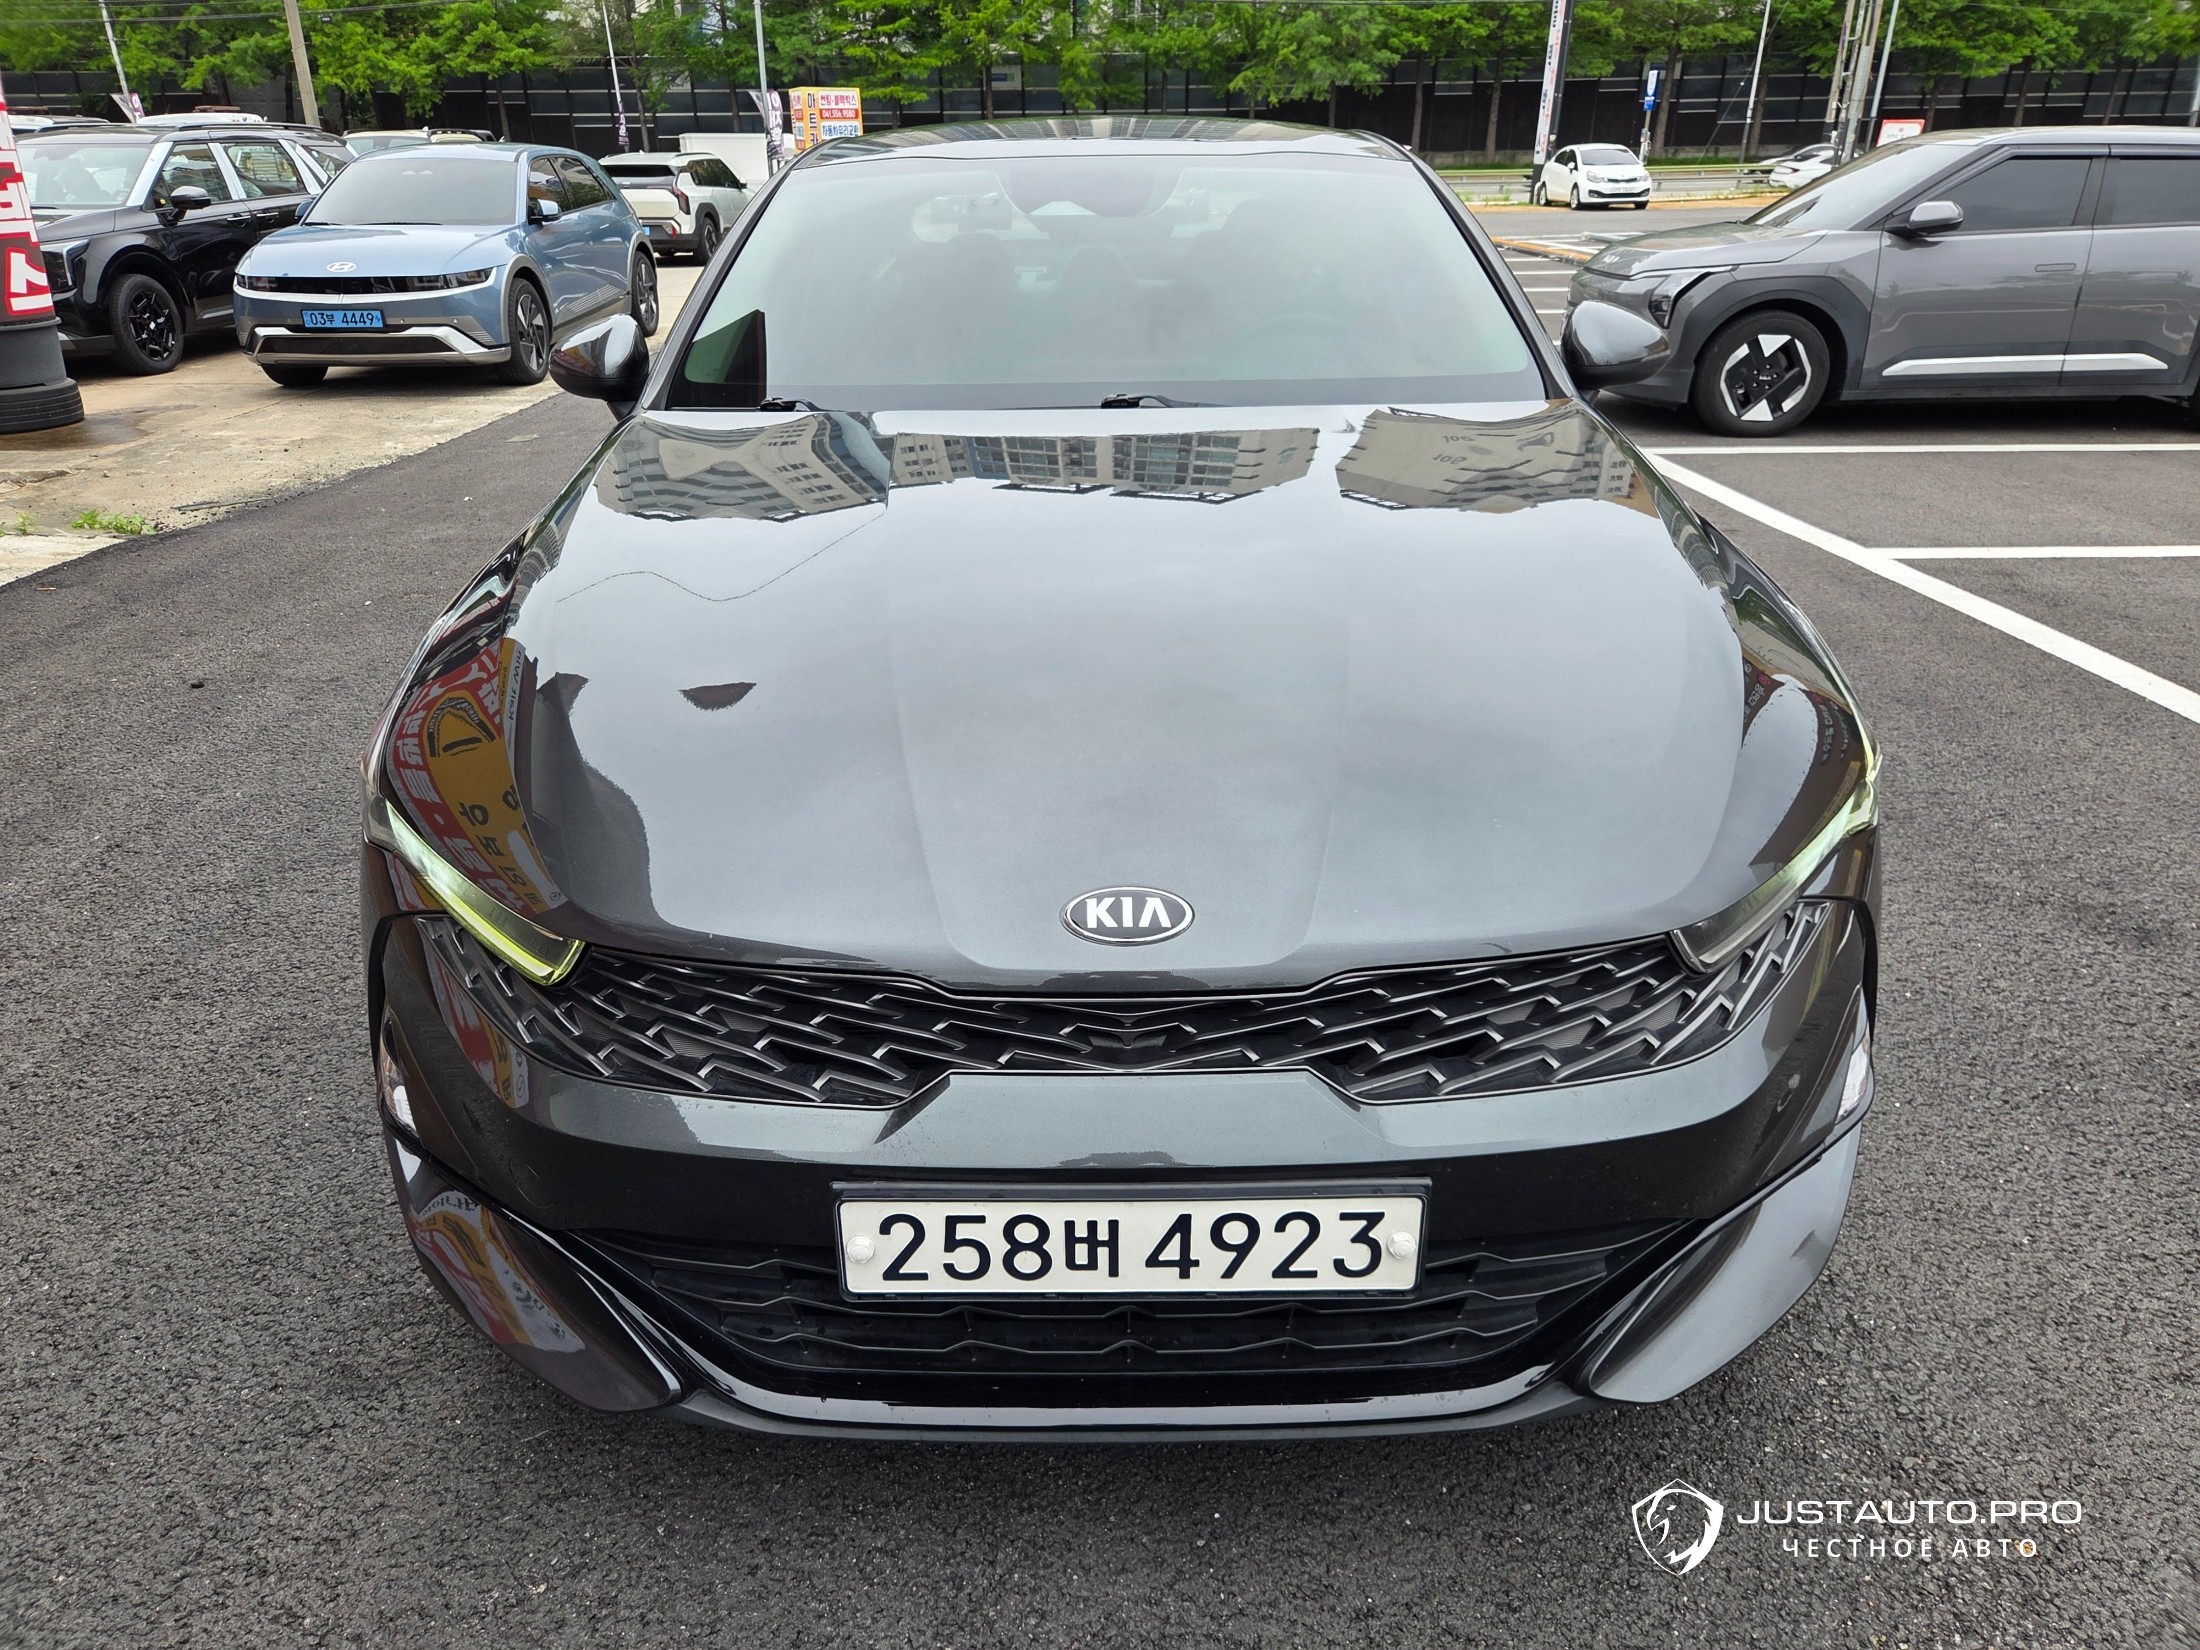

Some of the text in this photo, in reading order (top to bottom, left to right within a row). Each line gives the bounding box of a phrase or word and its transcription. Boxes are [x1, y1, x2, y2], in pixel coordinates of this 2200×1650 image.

[309, 312, 375, 326] 03부 4449
[1085, 897, 1172, 929] KIA
[877, 1210, 1386, 1282] 258버 4923
